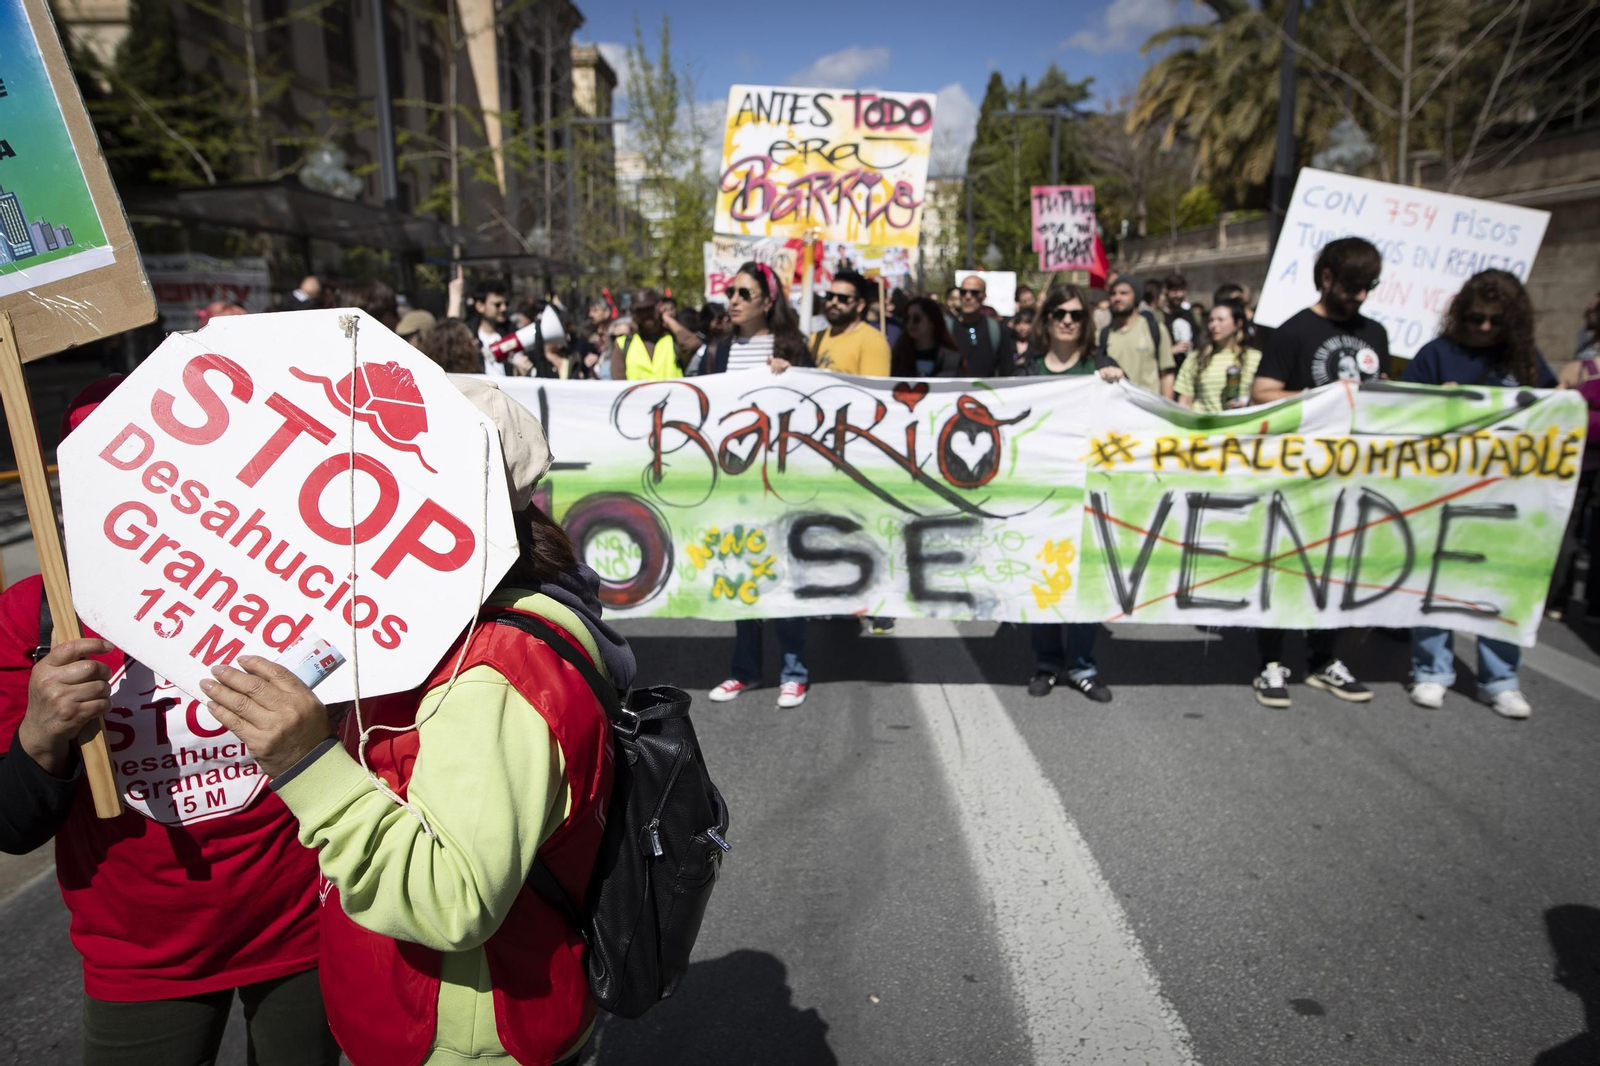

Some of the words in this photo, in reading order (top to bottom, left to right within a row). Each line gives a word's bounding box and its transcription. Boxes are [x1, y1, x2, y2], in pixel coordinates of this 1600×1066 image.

[735, 91, 834, 127] ANTES
[842, 90, 933, 132] TODO
[1302, 185, 1368, 217] CON
[1382, 197, 1438, 231] 754
[1278, 257, 1300, 284] A
[1412, 244, 1441, 270] EN
[151, 353, 476, 580] STOP
[98, 422, 409, 650] Desahucios
[786, 514, 983, 606] SE
[1090, 486, 1517, 616] VENDE
[103, 501, 314, 654] Granad
[133, 587, 196, 639] 15
[188, 624, 246, 667] M
[103, 697, 230, 752] STO
[126, 761, 259, 801] Granada
[167, 795, 198, 818] 15
[205, 787, 228, 809] M
